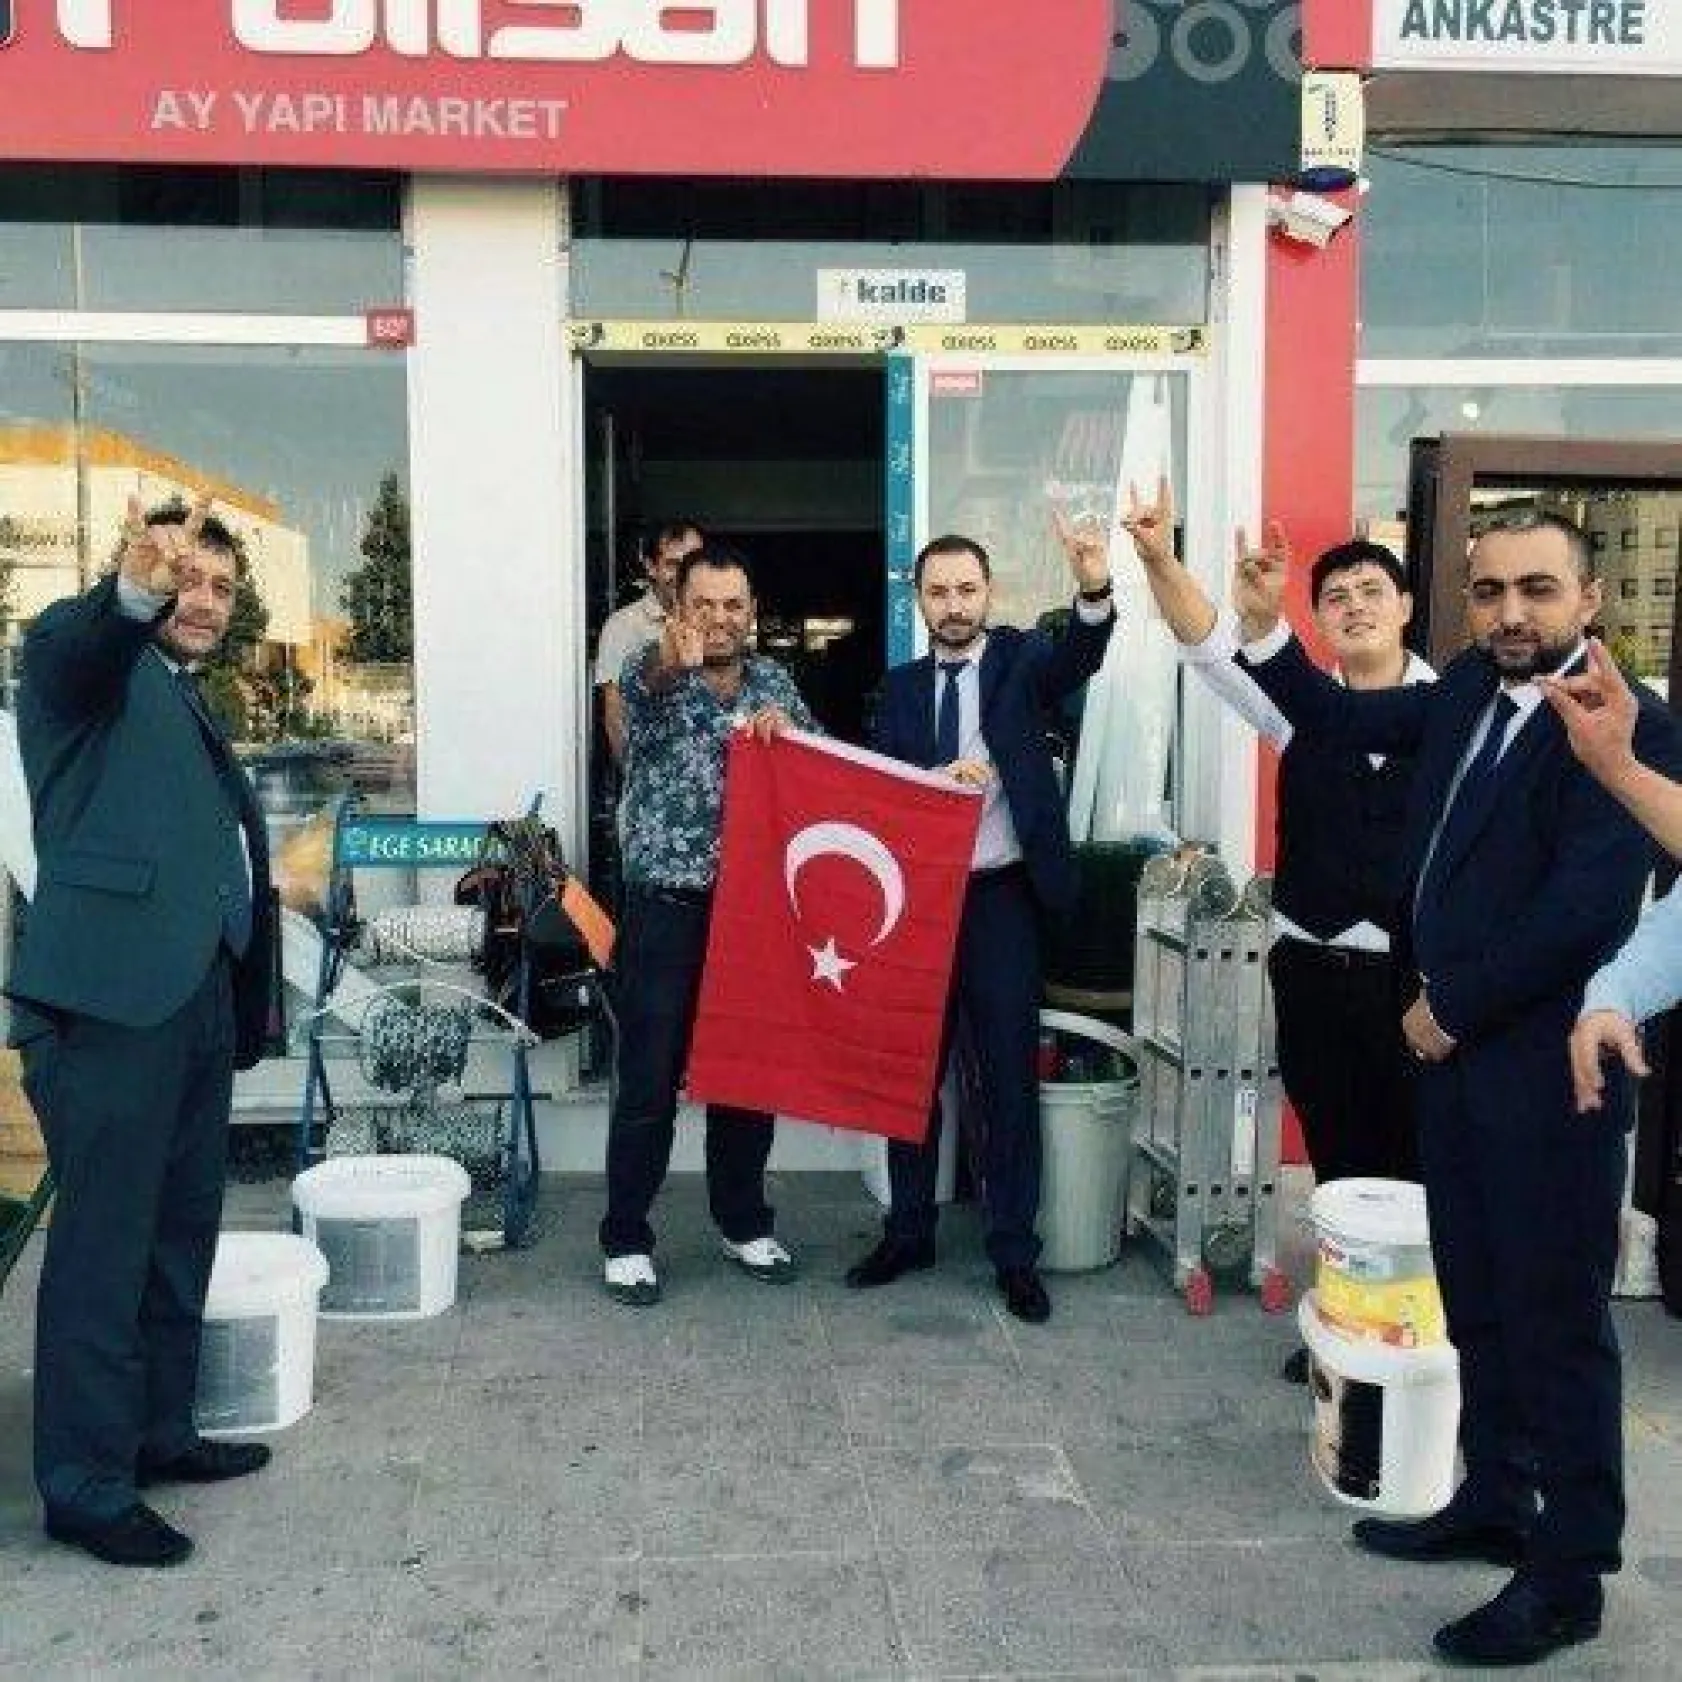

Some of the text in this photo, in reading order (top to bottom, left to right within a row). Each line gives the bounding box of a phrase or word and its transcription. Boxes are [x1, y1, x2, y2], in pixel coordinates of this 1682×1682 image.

[1400, 0, 1646, 45] ANKASTRE
[151, 90, 568, 139] AY YAPI MARKET
